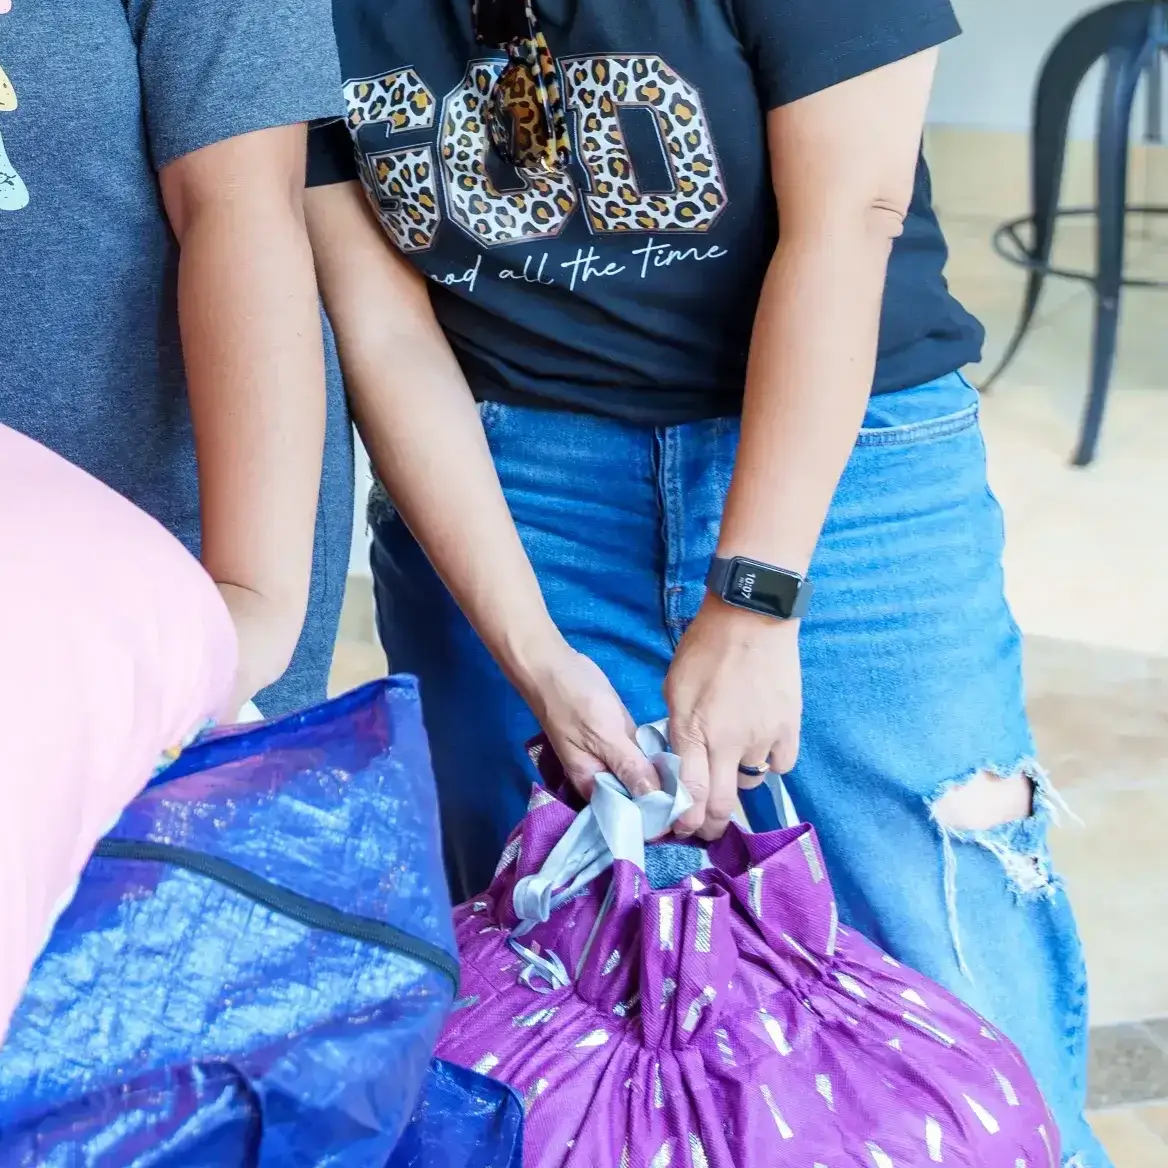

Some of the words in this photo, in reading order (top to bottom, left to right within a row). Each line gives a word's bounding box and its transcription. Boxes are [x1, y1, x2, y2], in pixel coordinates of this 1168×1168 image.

[343, 51, 729, 253] GOD
[499, 254, 554, 285] all
[561, 248, 625, 291] the
[741, 573, 757, 599] 10:07
